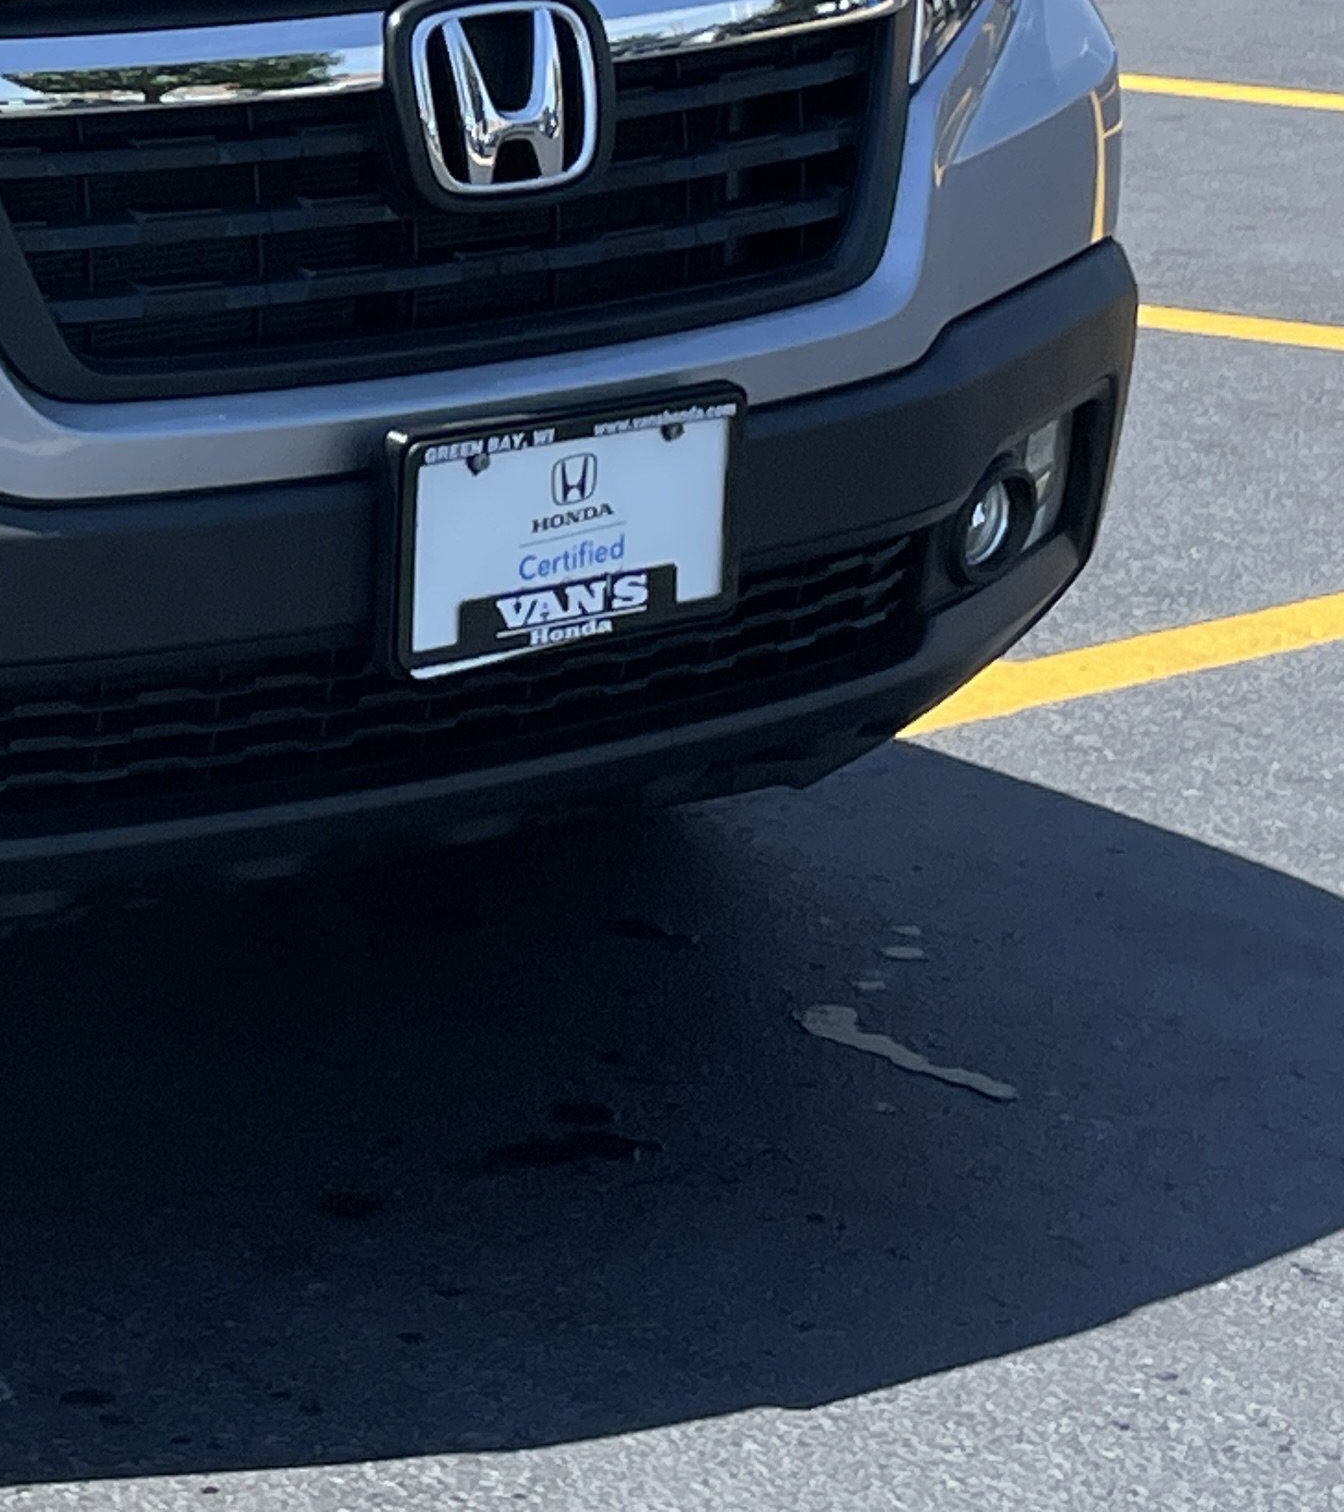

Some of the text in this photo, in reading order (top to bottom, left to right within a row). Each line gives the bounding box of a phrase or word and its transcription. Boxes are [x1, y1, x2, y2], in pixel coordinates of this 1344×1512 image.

[424, 439, 484, 465] GREEN
[533, 428, 556, 445] WI
[531, 502, 615, 534] HONDA
[518, 533, 626, 581] Certified
[529, 619, 612, 646] Honda
